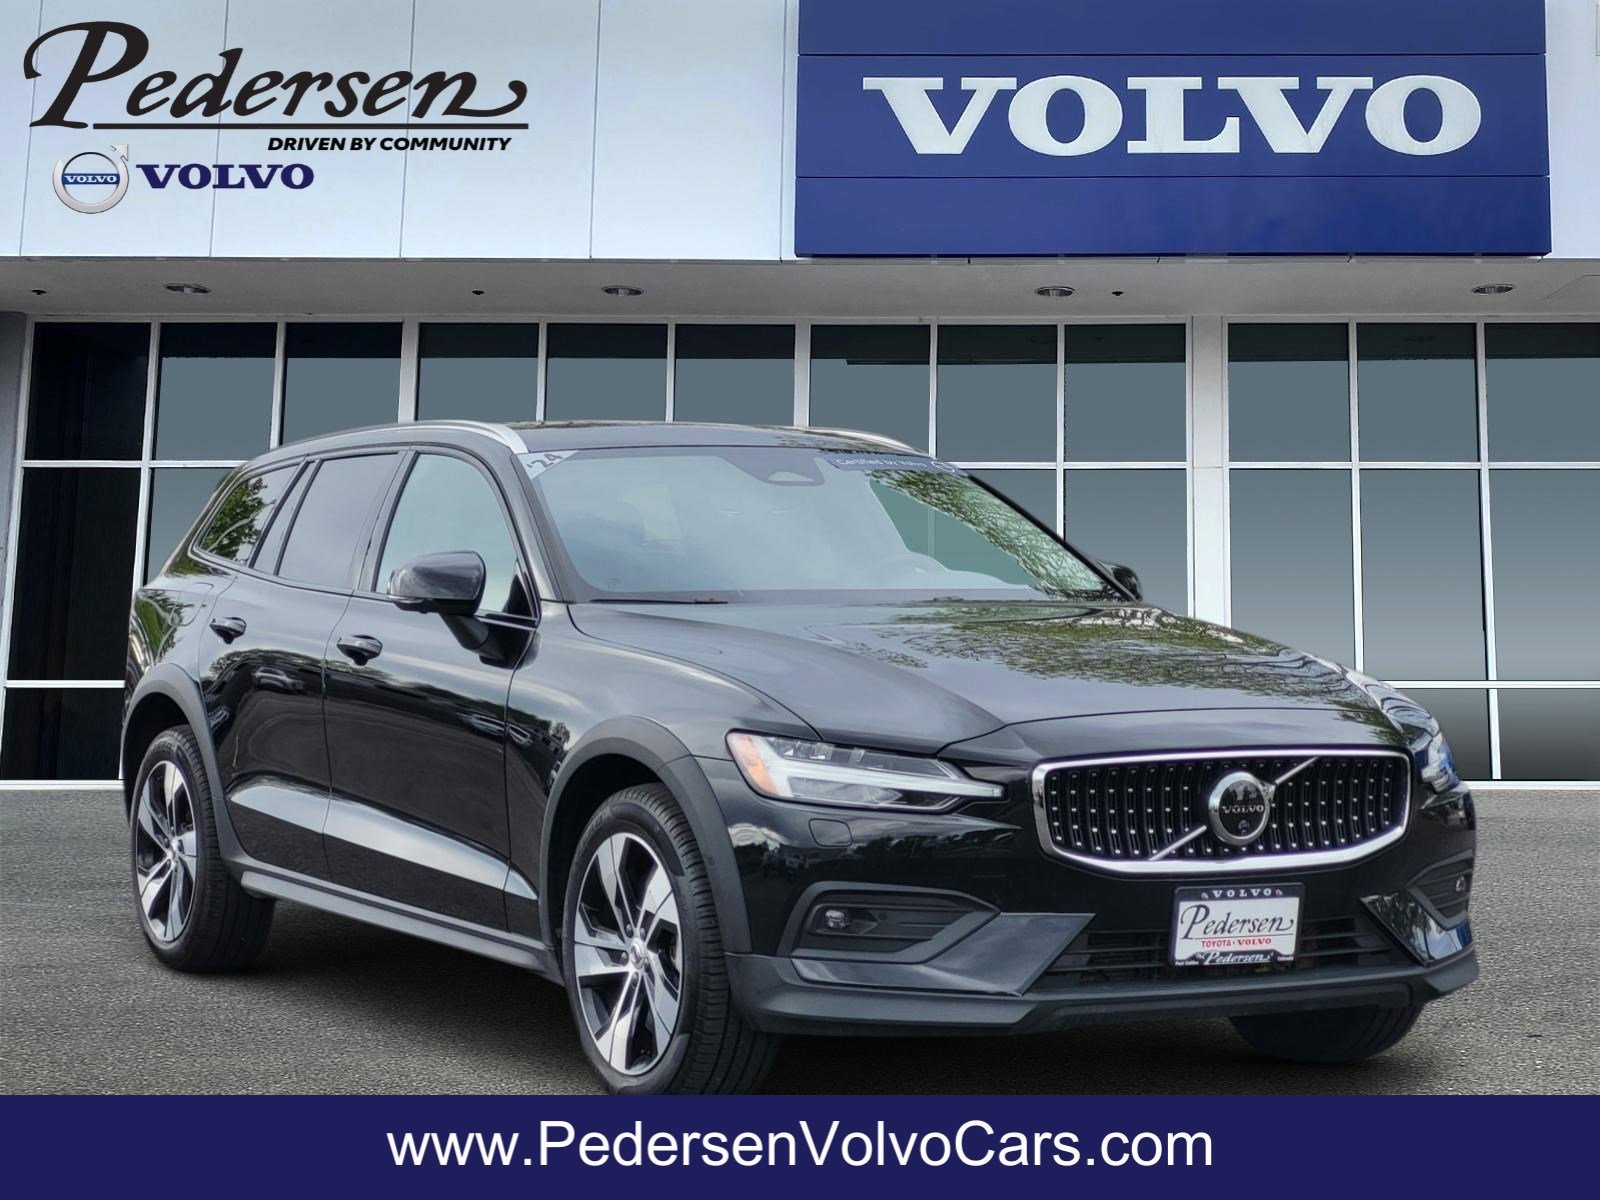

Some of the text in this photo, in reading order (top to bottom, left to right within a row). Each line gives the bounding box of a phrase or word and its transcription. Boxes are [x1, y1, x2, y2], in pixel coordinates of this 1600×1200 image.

[862, 74, 1482, 157] VOLVO
[1222, 804, 1265, 814] VOLVO
[1212, 888, 1272, 898] VOLVO
[1180, 903, 1295, 940] Pedersen
[1201, 938, 1272, 948] TOYOTA VOLVO
